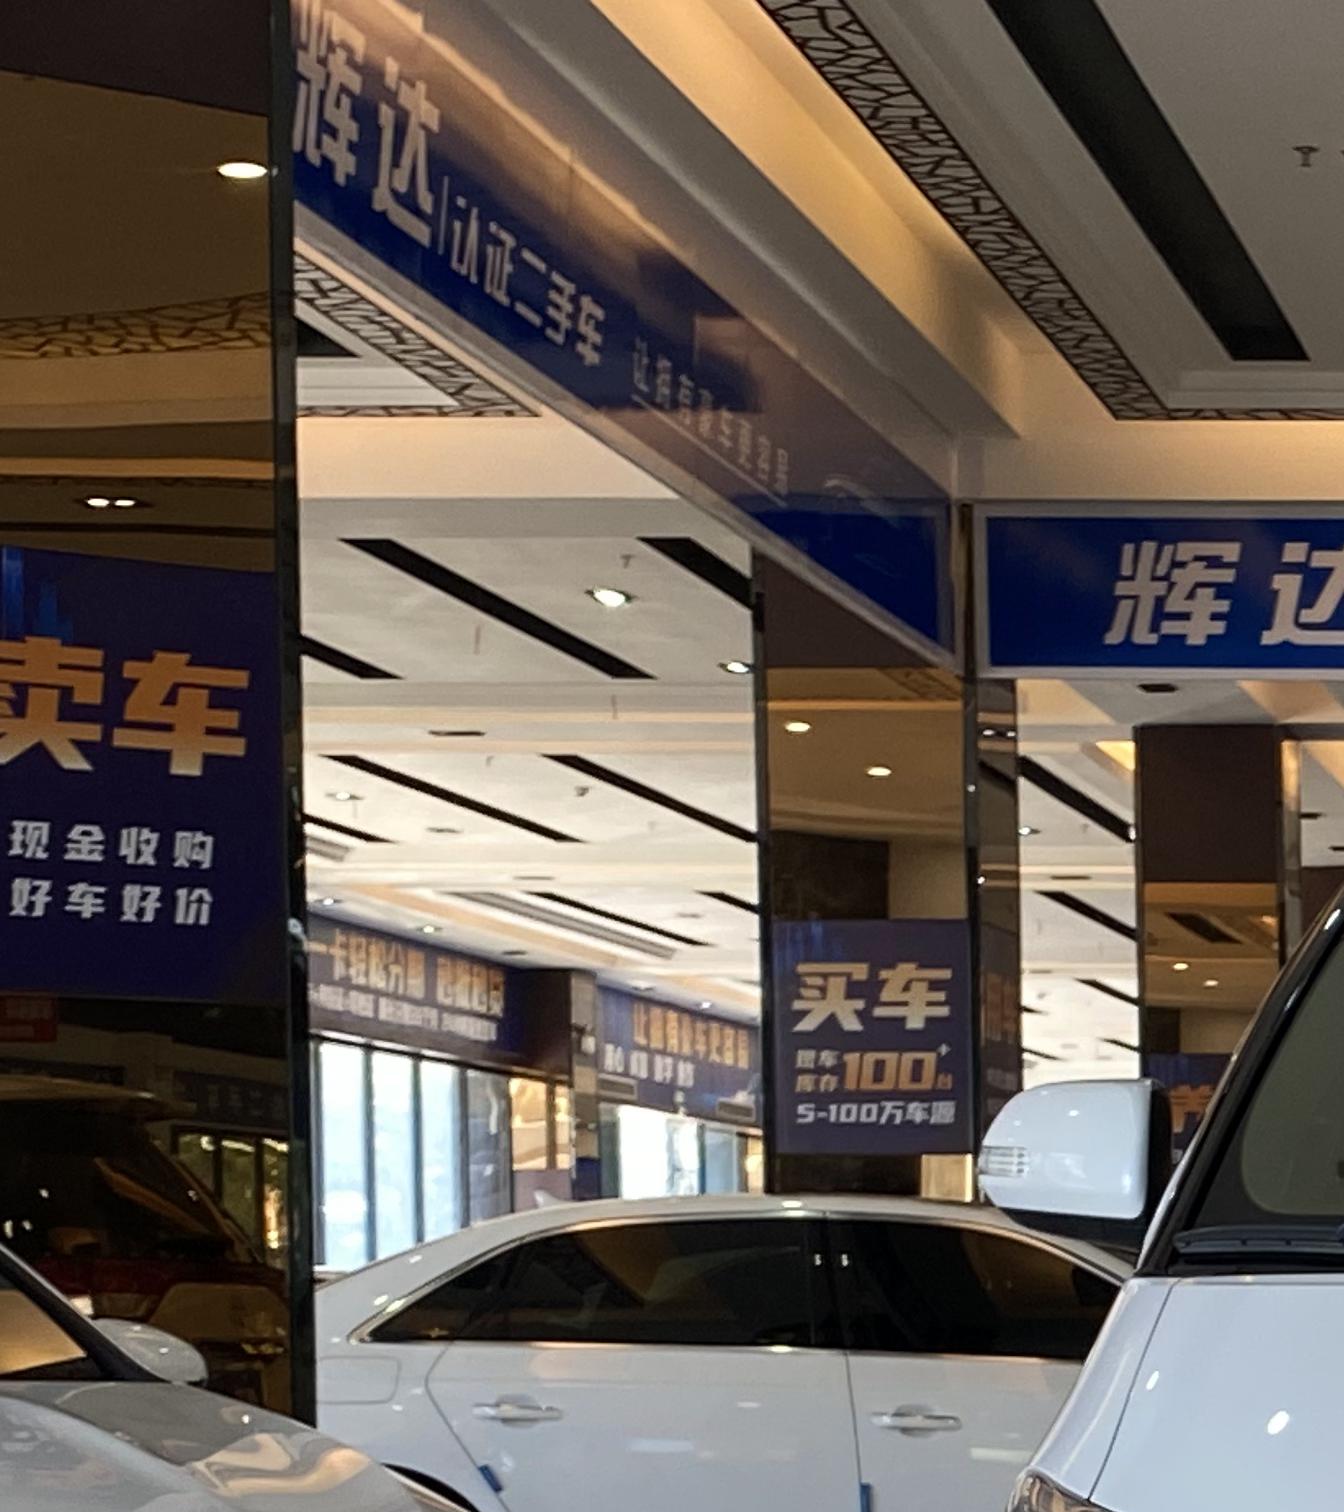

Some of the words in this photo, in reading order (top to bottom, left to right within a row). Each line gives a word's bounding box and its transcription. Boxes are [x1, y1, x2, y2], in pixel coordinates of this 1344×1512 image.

[0, 635, 250, 776] 卖车
[8, 820, 214, 869] 现金收购
[9, 877, 214, 926] 好车好价
[791, 962, 952, 1032] 买车
